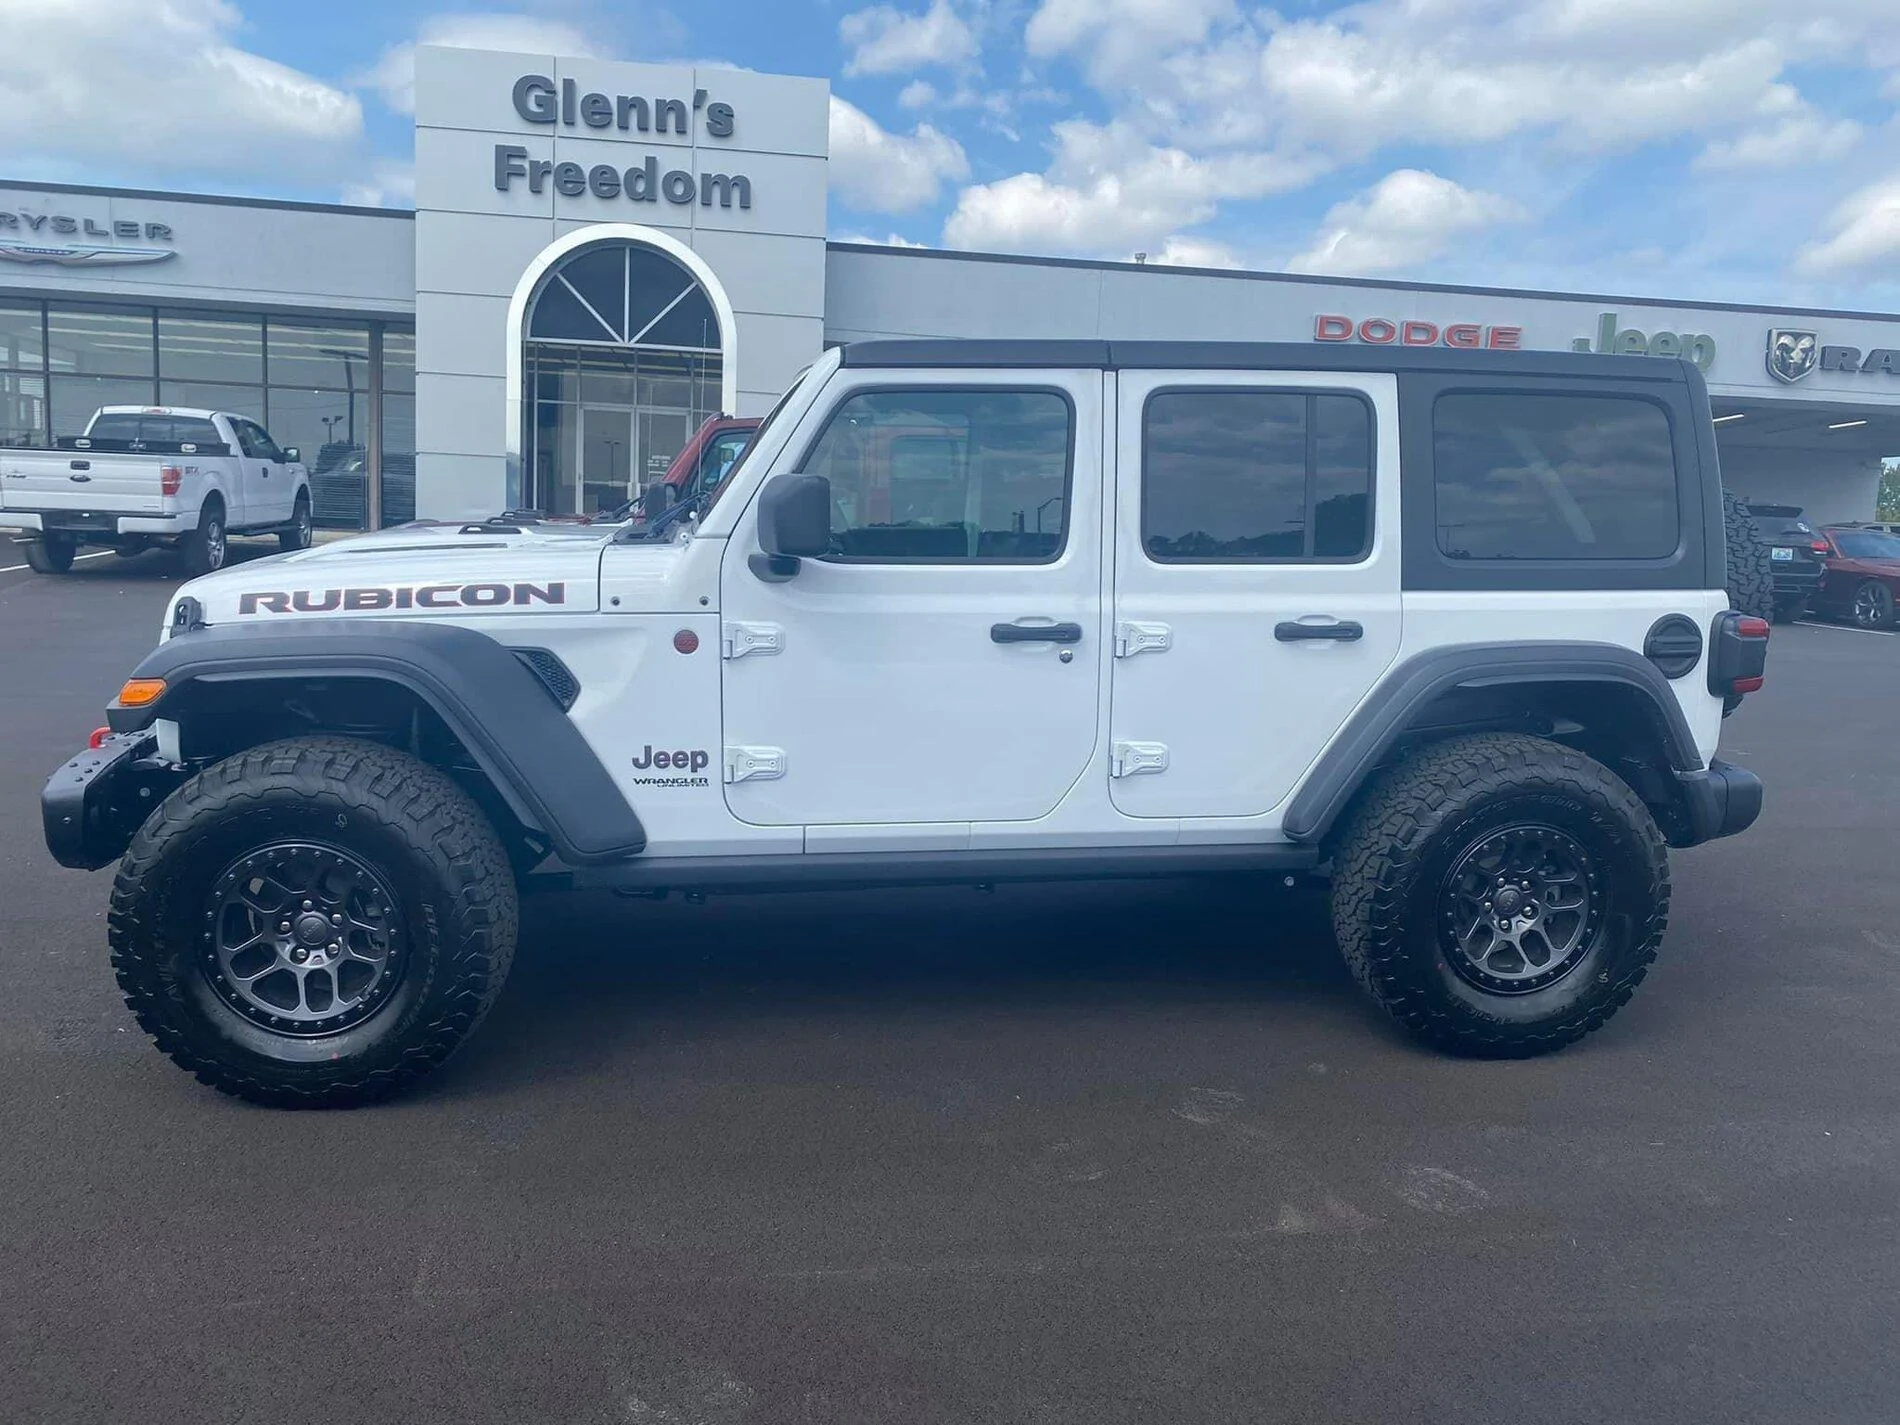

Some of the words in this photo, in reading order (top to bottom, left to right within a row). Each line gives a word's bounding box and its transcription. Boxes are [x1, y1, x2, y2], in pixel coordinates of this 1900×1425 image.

[512, 75, 735, 137] Glenn's
[494, 145, 752, 209] Freedom
[1314, 314, 1522, 350] DODGE
[1572, 313, 1716, 372] Jeep
[238, 582, 565, 615] RUBICON
[632, 745, 709, 773] Jeep
[633, 777, 708, 785] WRANGLER
